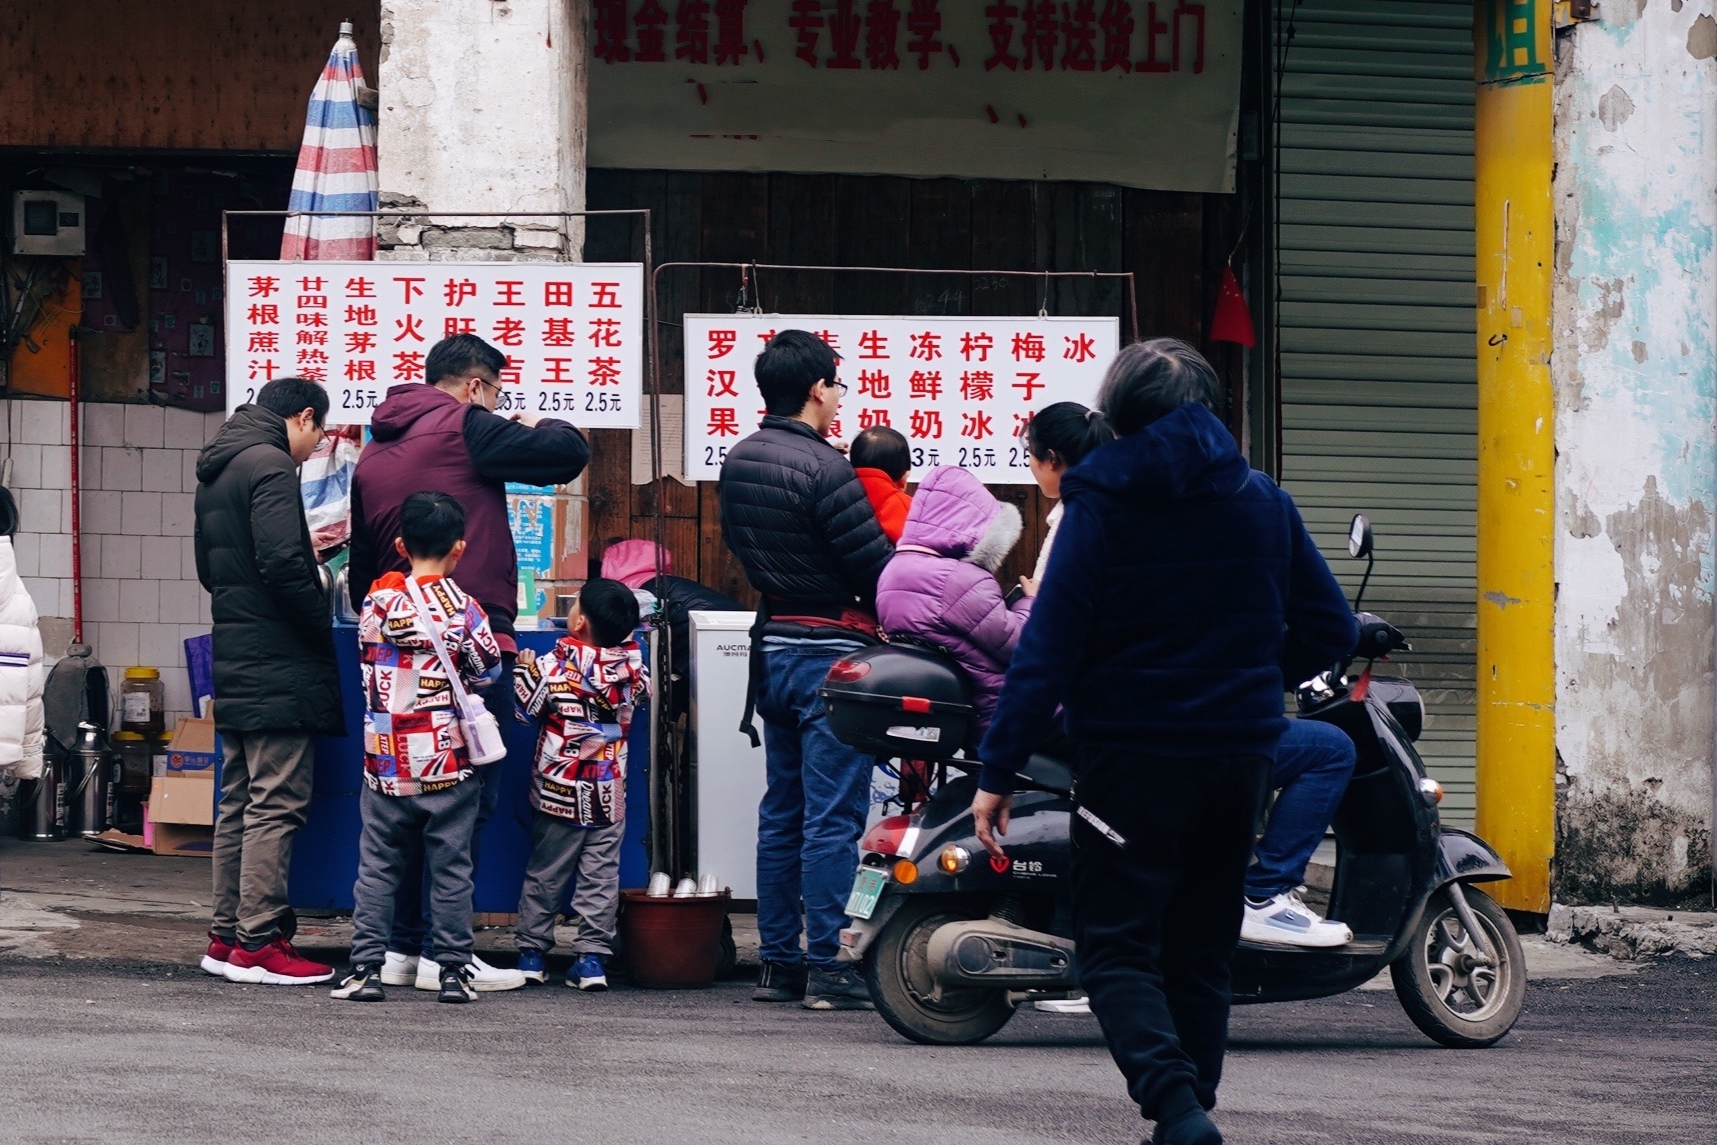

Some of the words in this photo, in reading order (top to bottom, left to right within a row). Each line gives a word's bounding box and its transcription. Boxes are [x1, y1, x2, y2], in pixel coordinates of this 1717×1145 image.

[246, 275, 280, 382] 茅根蔗汁
[344, 277, 378, 382] 生地茅根
[392, 277, 426, 382] 下火茶
[492, 281, 526, 385] 王老吉
[541, 281, 575, 385] 田基王
[587, 282, 623, 387] 五花茶
[538, 392, 575, 412] 2.5元
[585, 392, 622, 413] 2.5元
[706, 329, 740, 438] 罗汉果
[908, 331, 943, 440] 冻鲜奶
[959, 331, 995, 440] 柠檬冰
[958, 447, 996, 468] 2.5元
[433, 584, 456, 618] HAPPY
[541, 802, 572, 816] HAPPY
[544, 781, 573, 796] HAPPY
